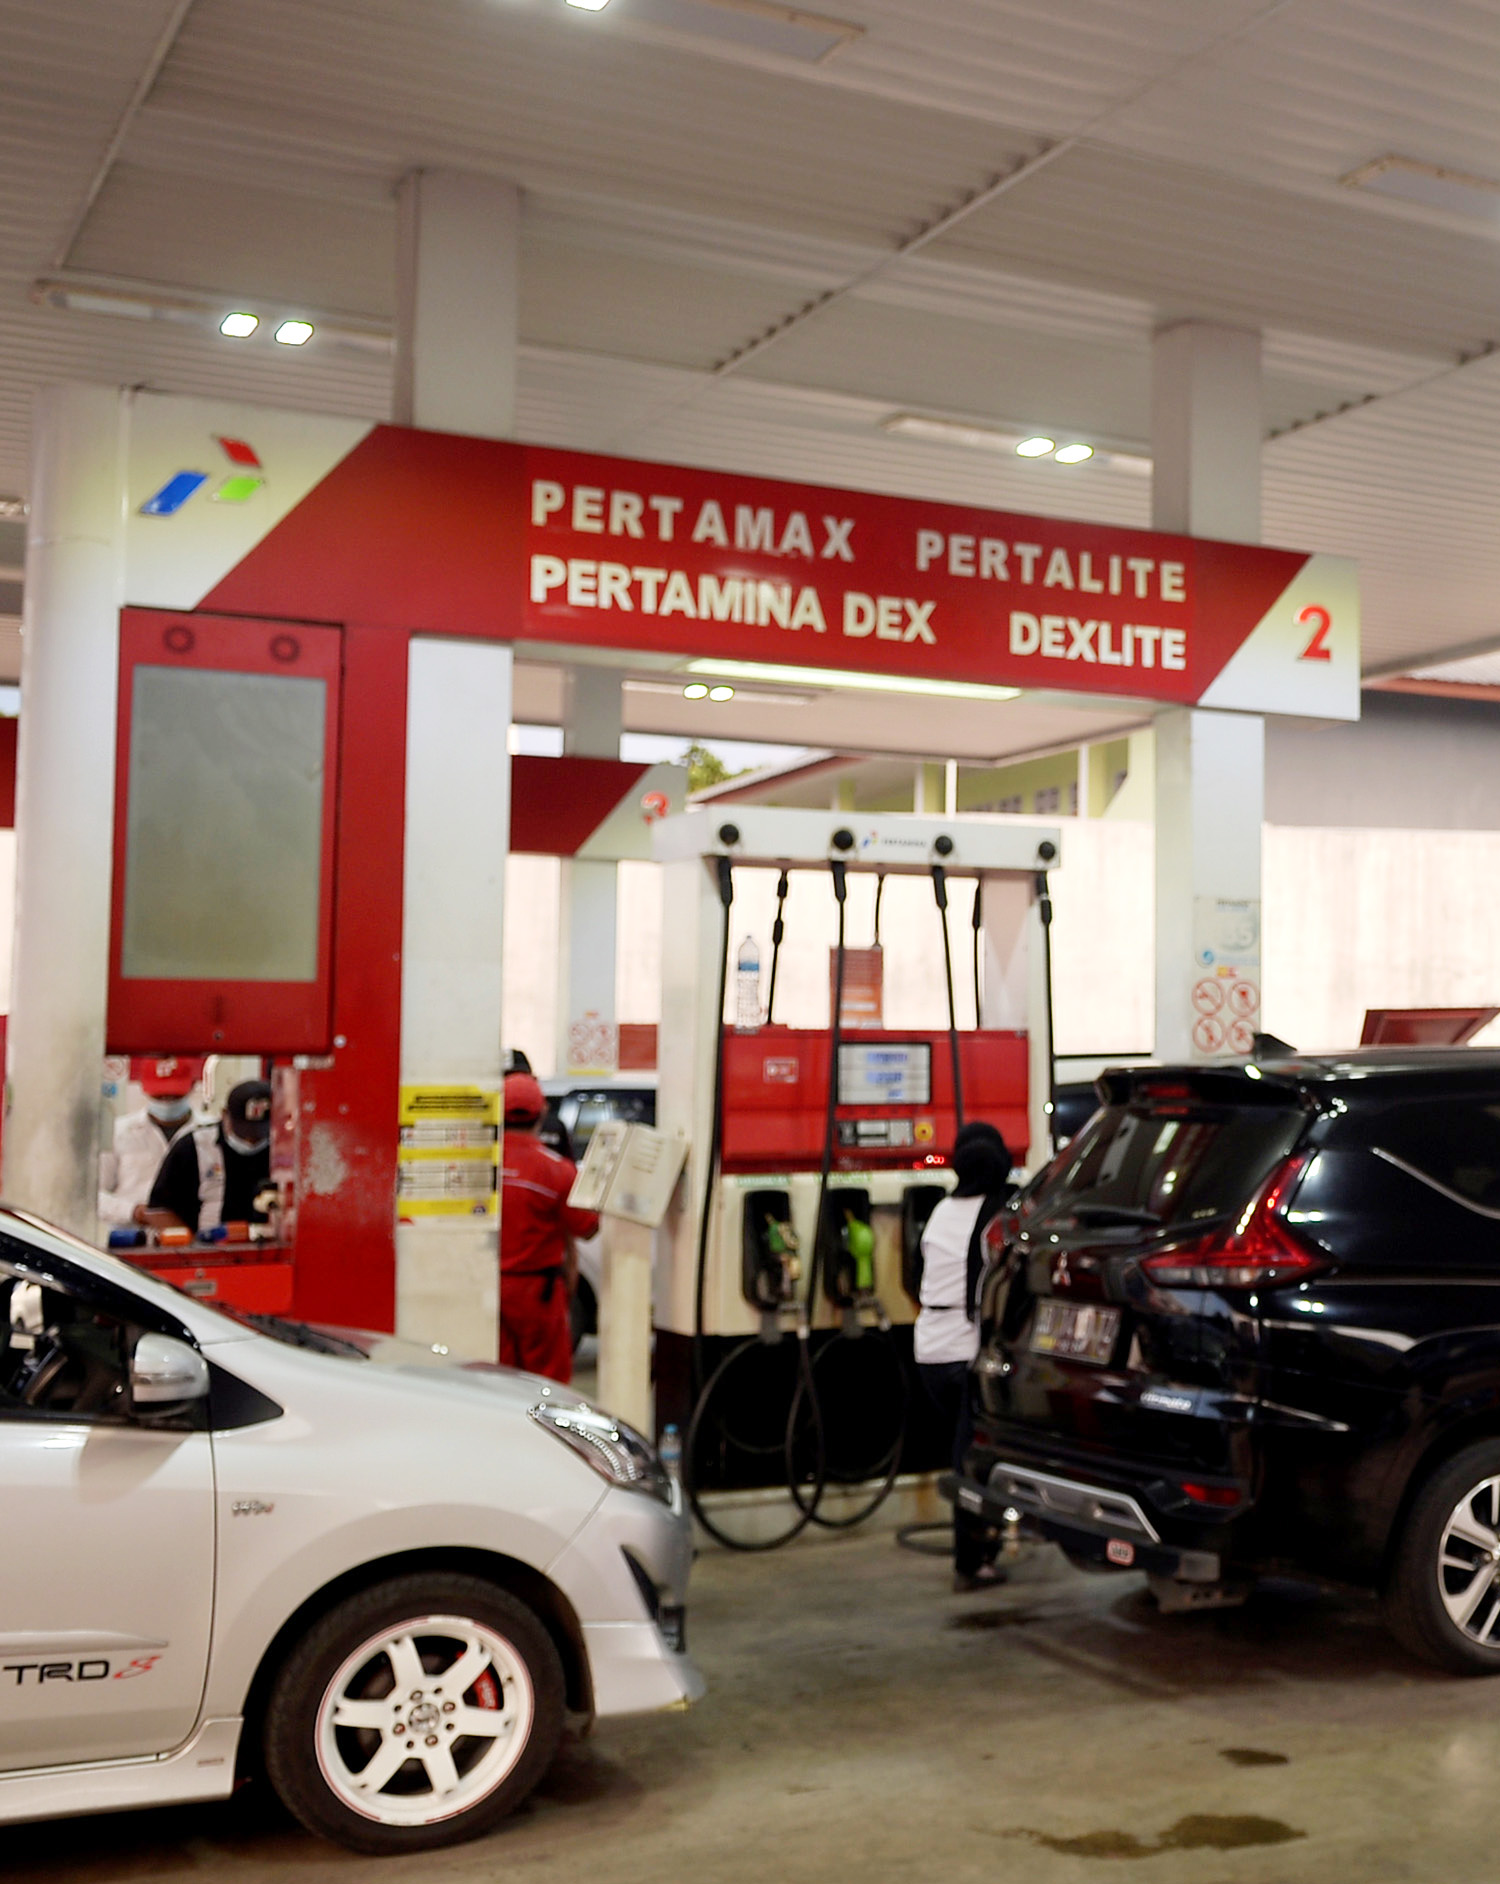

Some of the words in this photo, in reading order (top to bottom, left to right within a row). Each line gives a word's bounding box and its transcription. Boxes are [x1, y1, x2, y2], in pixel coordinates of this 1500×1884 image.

[531, 479, 856, 563] PERTAMAX
[529, 553, 827, 634] PERTAMINA
[843, 590, 937, 646] DEX
[916, 529, 1187, 603] PERTALITE
[1009, 610, 1187, 671] DEXLITE
[1293, 603, 1332, 664] 2
[3, 1660, 110, 1686] TRD
